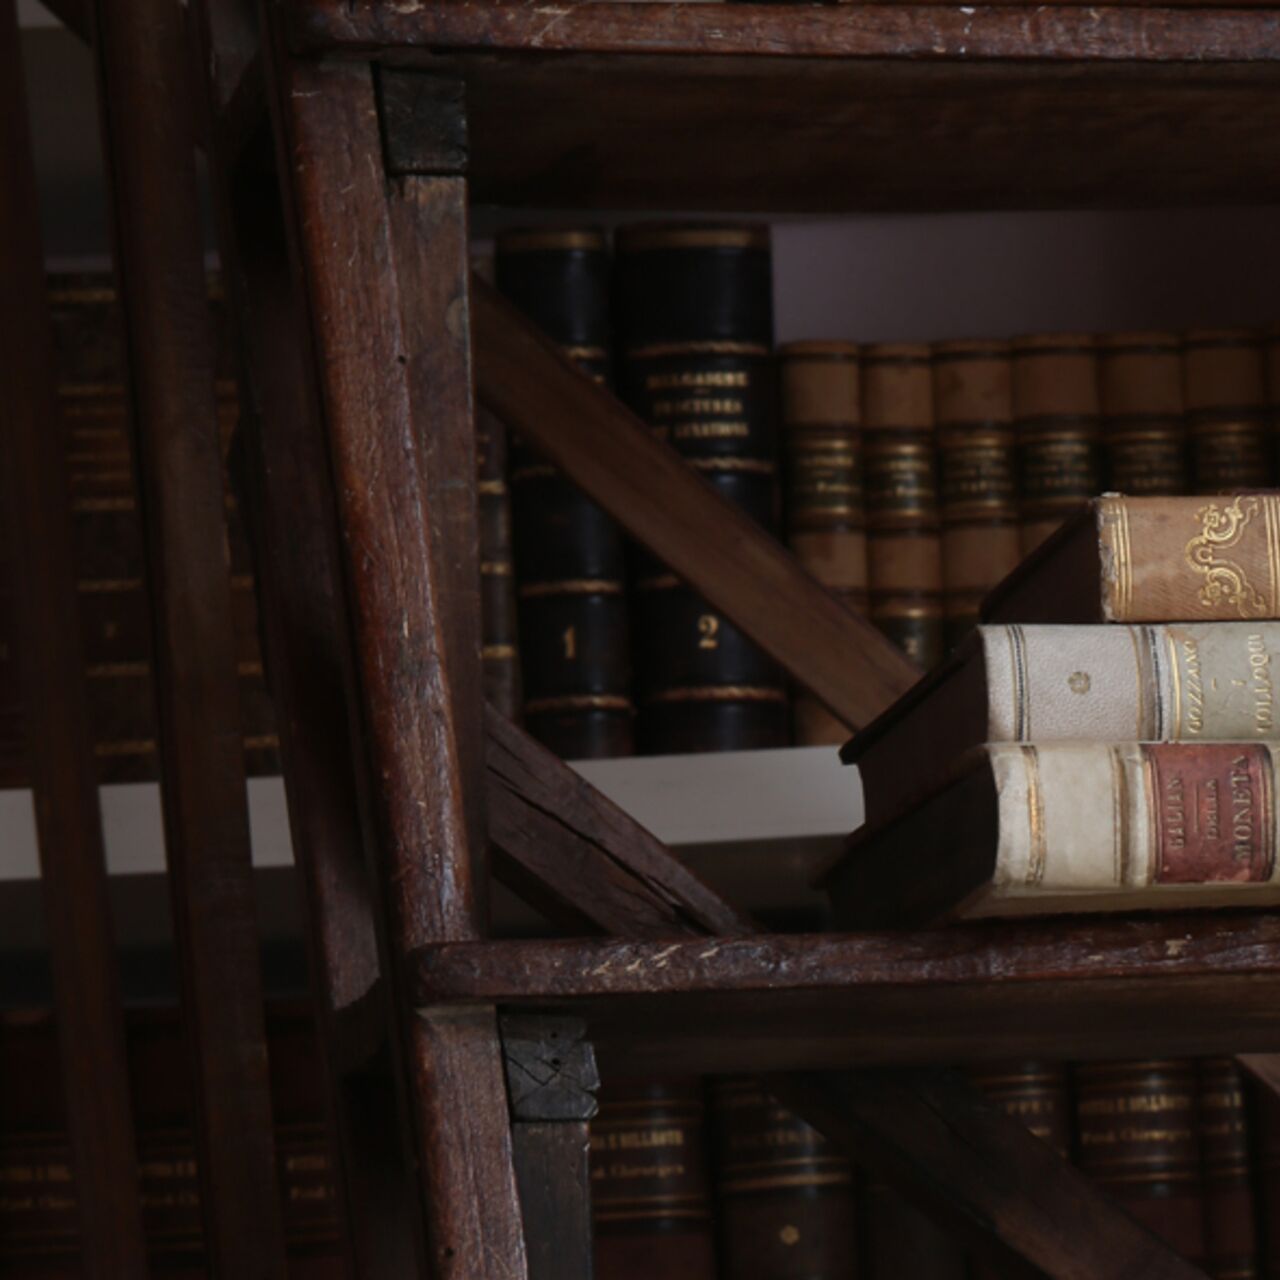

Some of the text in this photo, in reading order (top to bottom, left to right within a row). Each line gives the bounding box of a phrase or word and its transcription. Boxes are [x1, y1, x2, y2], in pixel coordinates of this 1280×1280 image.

[563, 623, 576, 659] 1
[697, 613, 720, 649] 2
[1183, 640, 1204, 734] GOZZANO
[1247, 634, 1272, 734] COLLOQUI
[1230, 755, 1254, 862] MONETA
